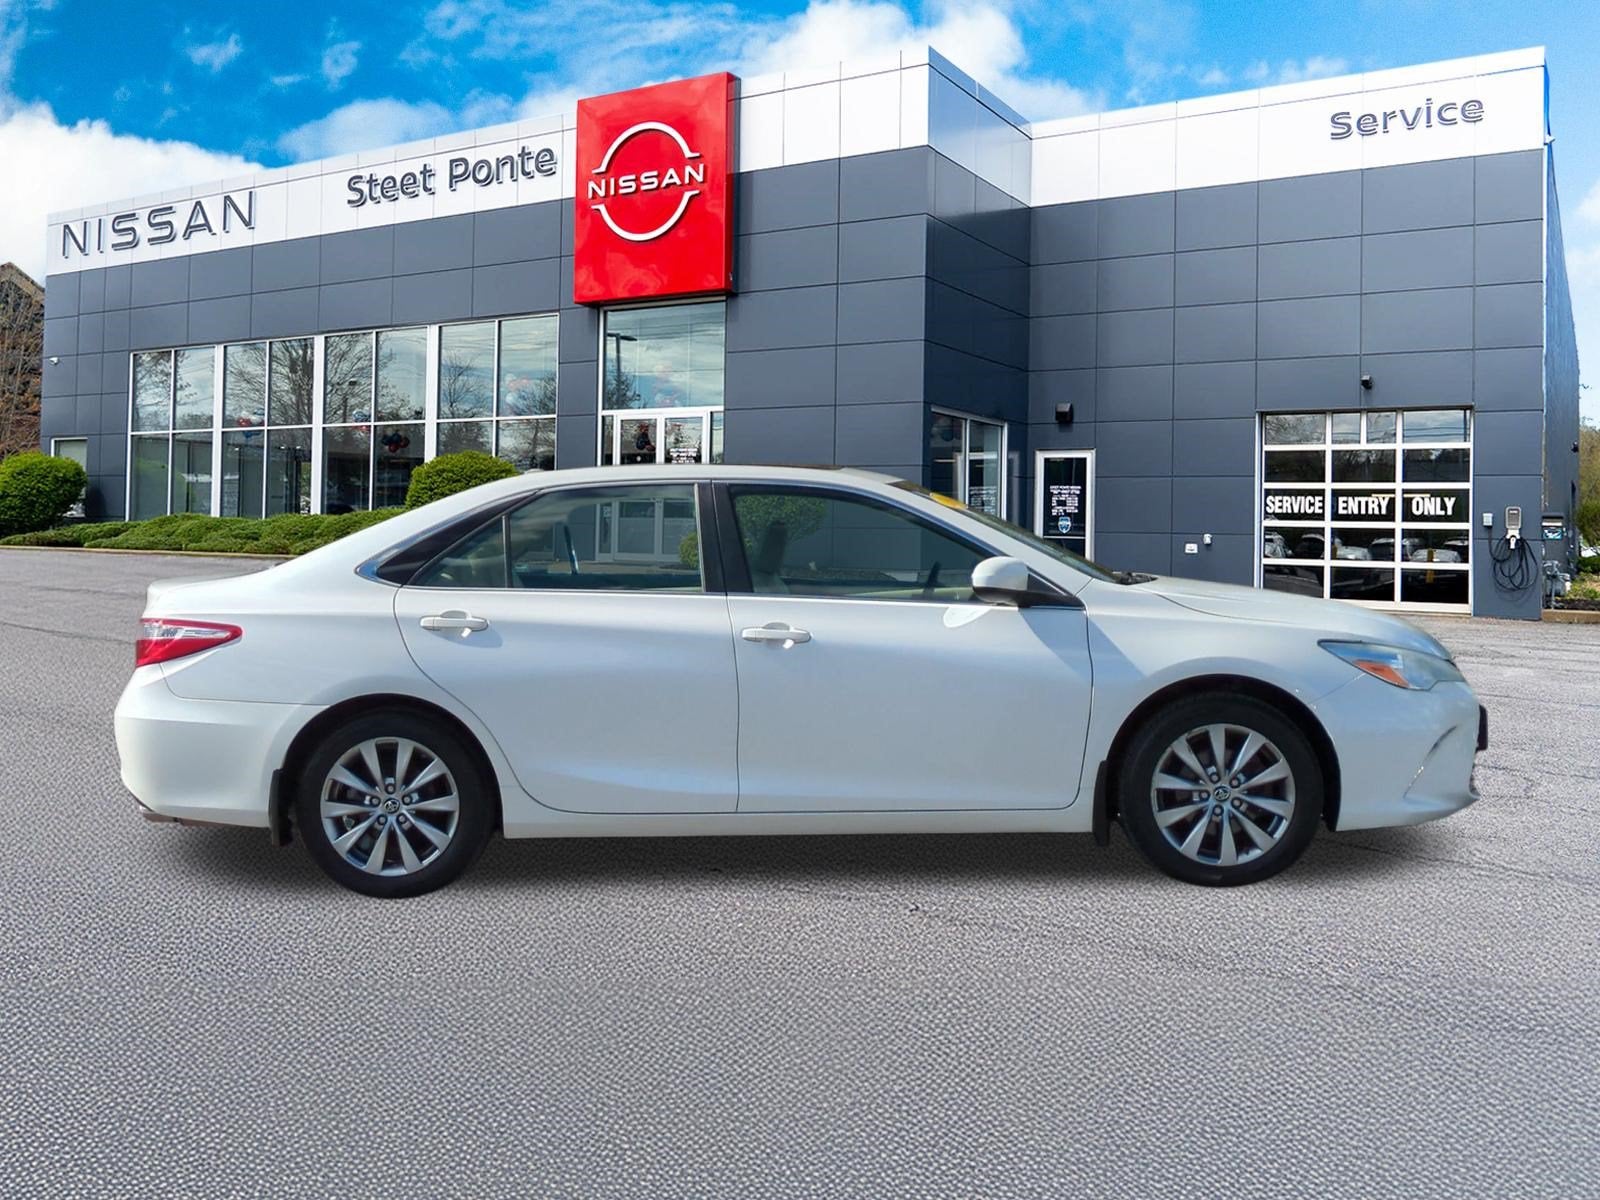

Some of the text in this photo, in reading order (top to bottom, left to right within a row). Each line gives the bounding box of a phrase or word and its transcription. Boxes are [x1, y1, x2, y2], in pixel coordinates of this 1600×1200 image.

[1330, 97, 1485, 140] Service
[347, 145, 558, 207] Steet Ponte
[587, 163, 705, 200] NISSAN
[62, 190, 256, 260] NISSAN
[1266, 495, 1456, 517] SERVICE ENTRY ONLY
